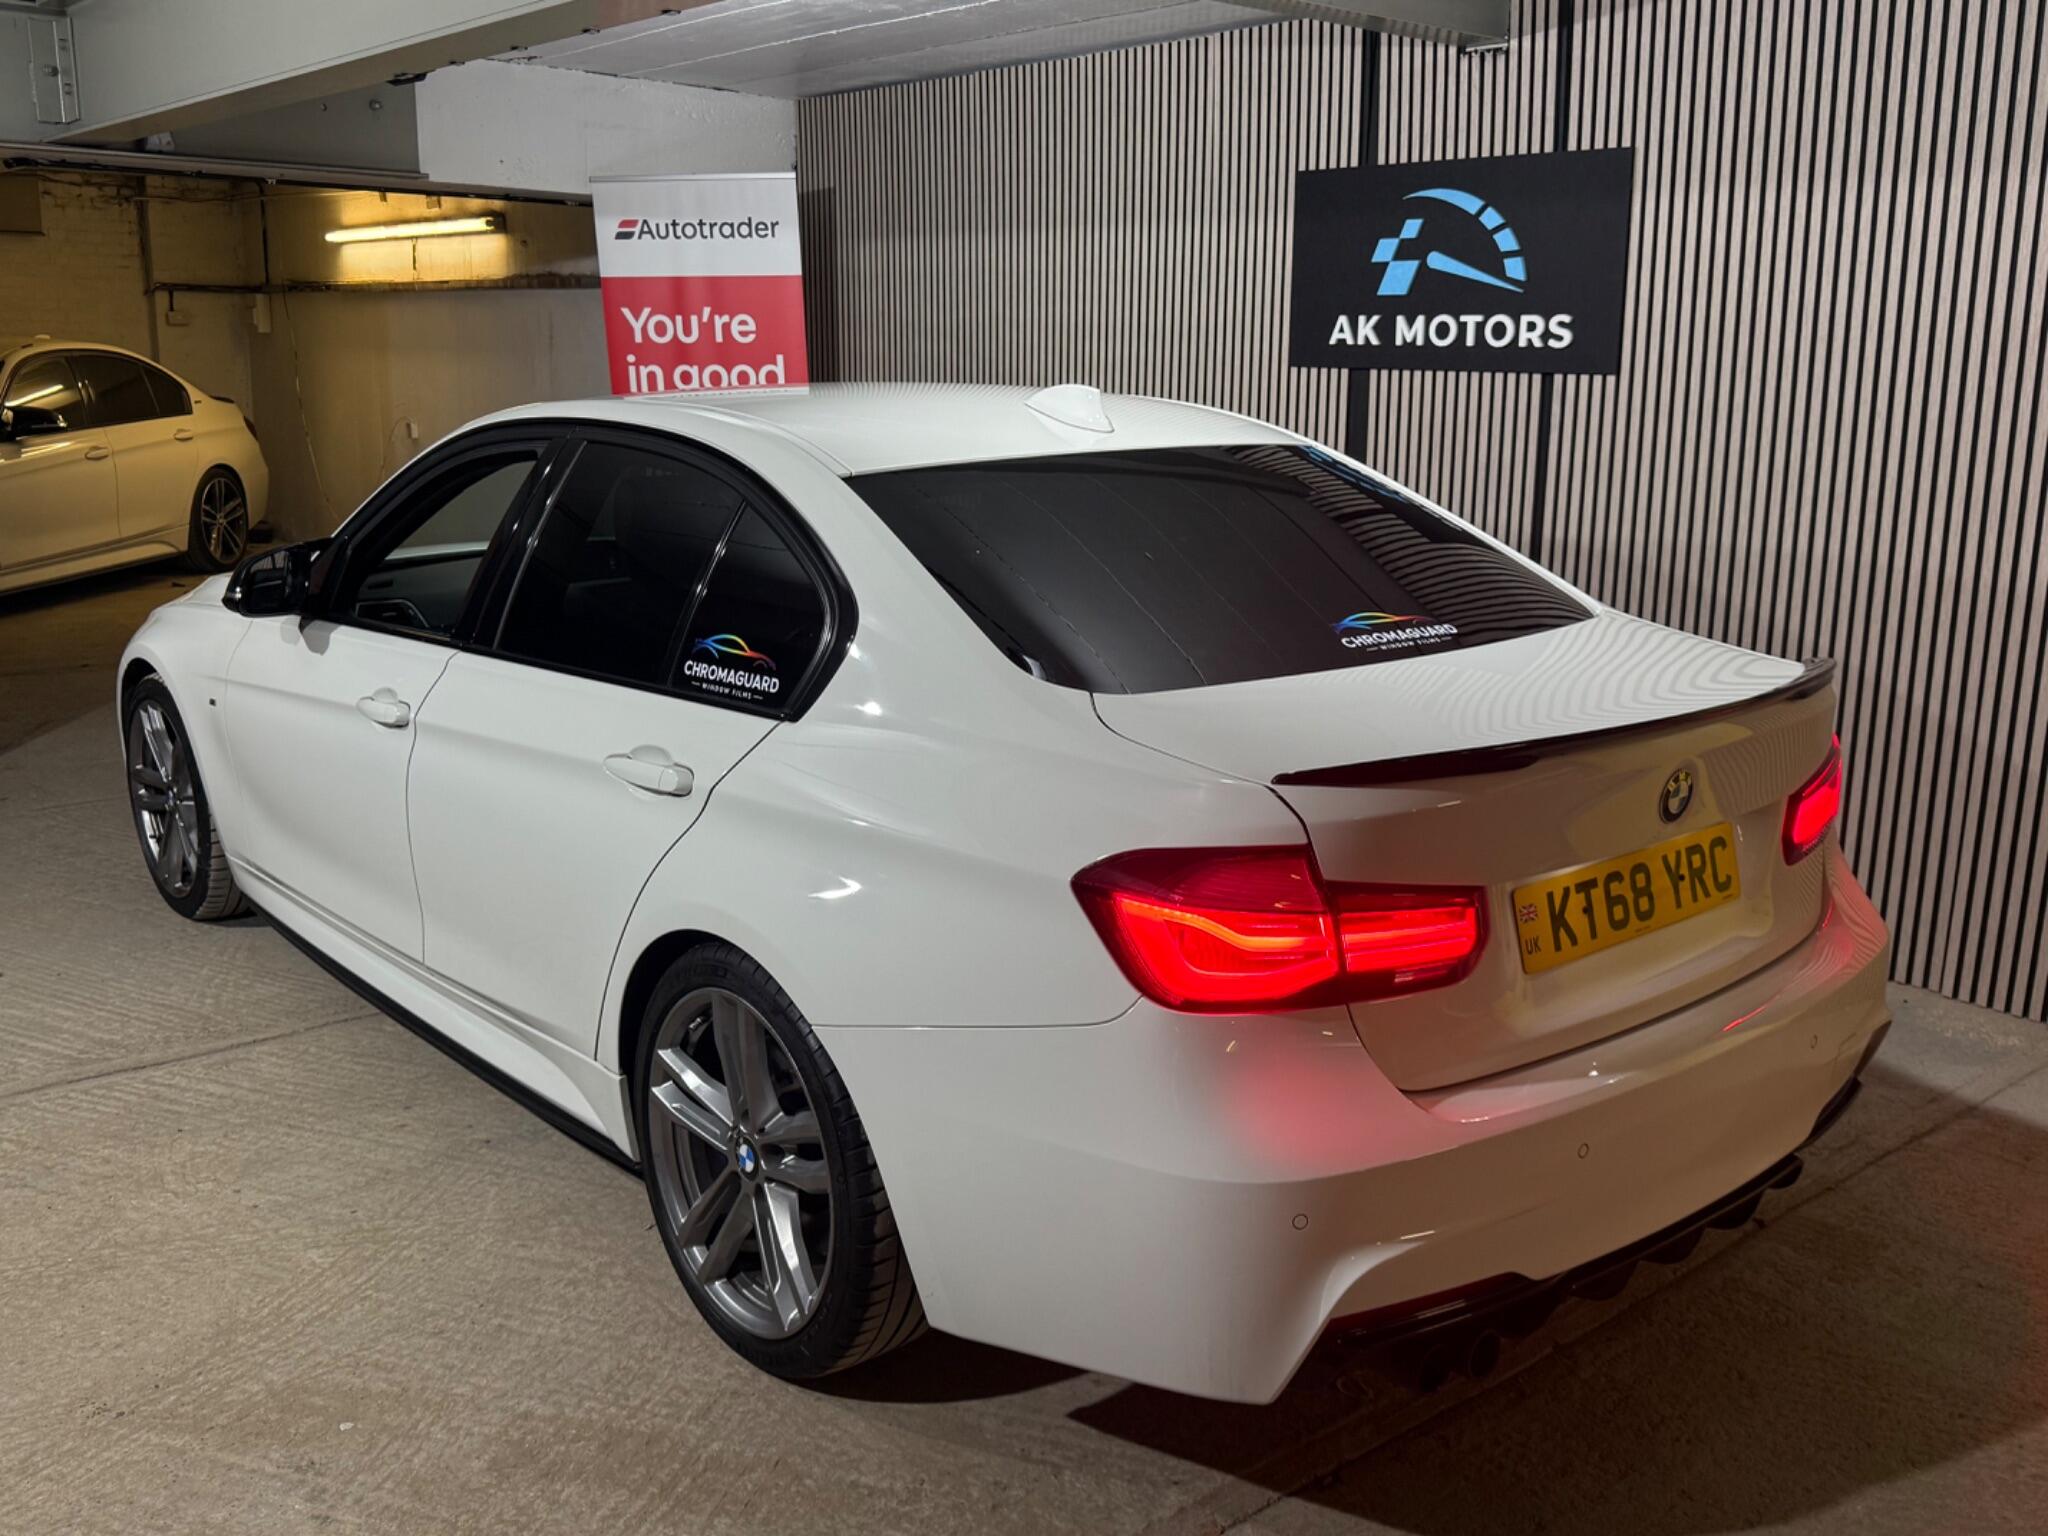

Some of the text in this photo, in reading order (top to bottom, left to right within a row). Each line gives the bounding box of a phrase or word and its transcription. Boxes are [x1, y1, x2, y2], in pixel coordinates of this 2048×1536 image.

[637, 216, 779, 240] Autotrader
[620, 306, 757, 344] You're
[1328, 313, 1574, 349] AK MOTORS
[626, 354, 665, 393] in
[1341, 623, 1458, 648] CHROMAGUARD
[1380, 637, 1441, 650] WINDOW FILMS
[684, 660, 780, 693] CHROMAGUARD
[702, 682, 752, 700] WINDOW FILMS
[1546, 836, 1732, 953] KT68 YRC
[1524, 936, 1542, 955] UK
